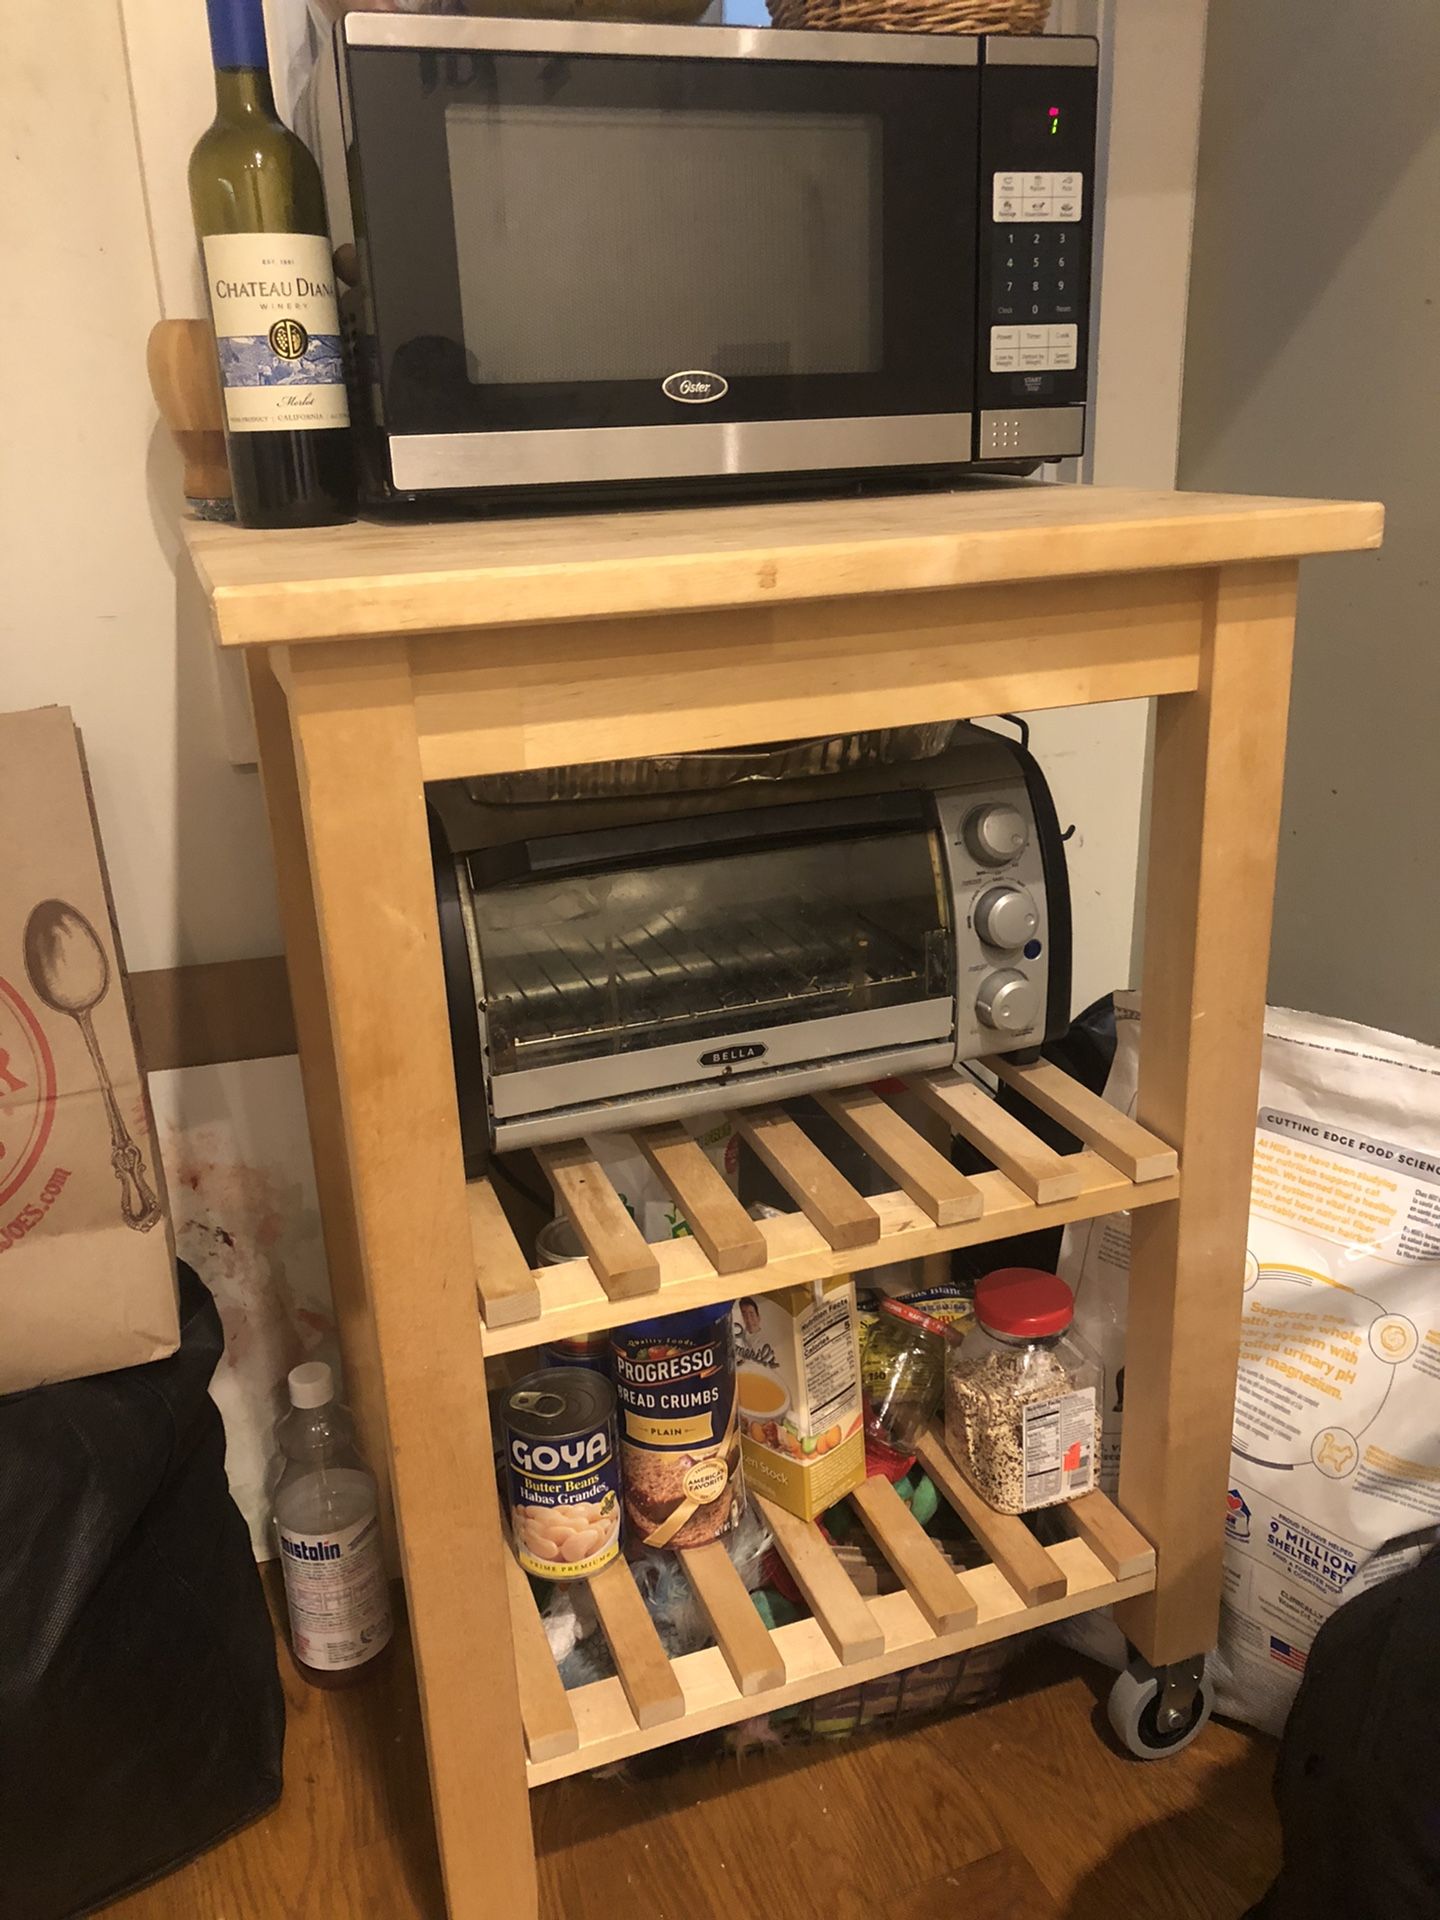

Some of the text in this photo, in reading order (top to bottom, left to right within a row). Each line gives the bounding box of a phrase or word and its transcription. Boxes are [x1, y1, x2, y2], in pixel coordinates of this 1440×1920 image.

[1008, 233, 1014, 244] 1
[1033, 233, 1040, 244] 2
[1059, 233, 1066, 244] 3
[1006, 258, 1013, 267] 4
[1033, 258, 1040, 268] 5
[1058, 258, 1065, 267] 6
[216, 280, 292, 299] CHATEAU
[1007, 282, 1013, 292] 7
[1032, 281, 1039, 292] 8
[1058, 280, 1064, 291] 9
[260, 303, 308, 311] WINERY
[1032, 304, 1039, 314] 0
[680, 380, 711, 394] Oster
[276, 392, 315, 408] Merlot
[713, 1048, 755, 1062] BELLA
[1267, 1115, 1319, 1137] CUTTING
[1324, 1131, 1356, 1148] EDGE
[1359, 1142, 1394, 1160] FOOD
[1251, 1301, 1317, 1320] Supports
[1319, 1326, 1362, 1346] whole
[1330, 1343, 1358, 1365] with
[617, 1348, 713, 1383] PROGRESSO
[1283, 1346, 1335, 1376] urinary
[1334, 1368, 1357, 1385] pH
[617, 1384, 719, 1409] BREAD CRUMBS
[651, 1427, 682, 1436] PLAIN
[512, 1433, 607, 1471] GOYA
[760, 1461, 789, 1485] Stock
[525, 1474, 600, 1493] Butter Beans
[689, 1474, 724, 1492] FAVORITE
[521, 1487, 555, 1505] Habas
[1267, 1534, 1319, 1570] SHELTER
[1270, 1521, 1279, 1533] 9
[1286, 1529, 1357, 1575] MILLION
[529, 1560, 556, 1572] PRIME
